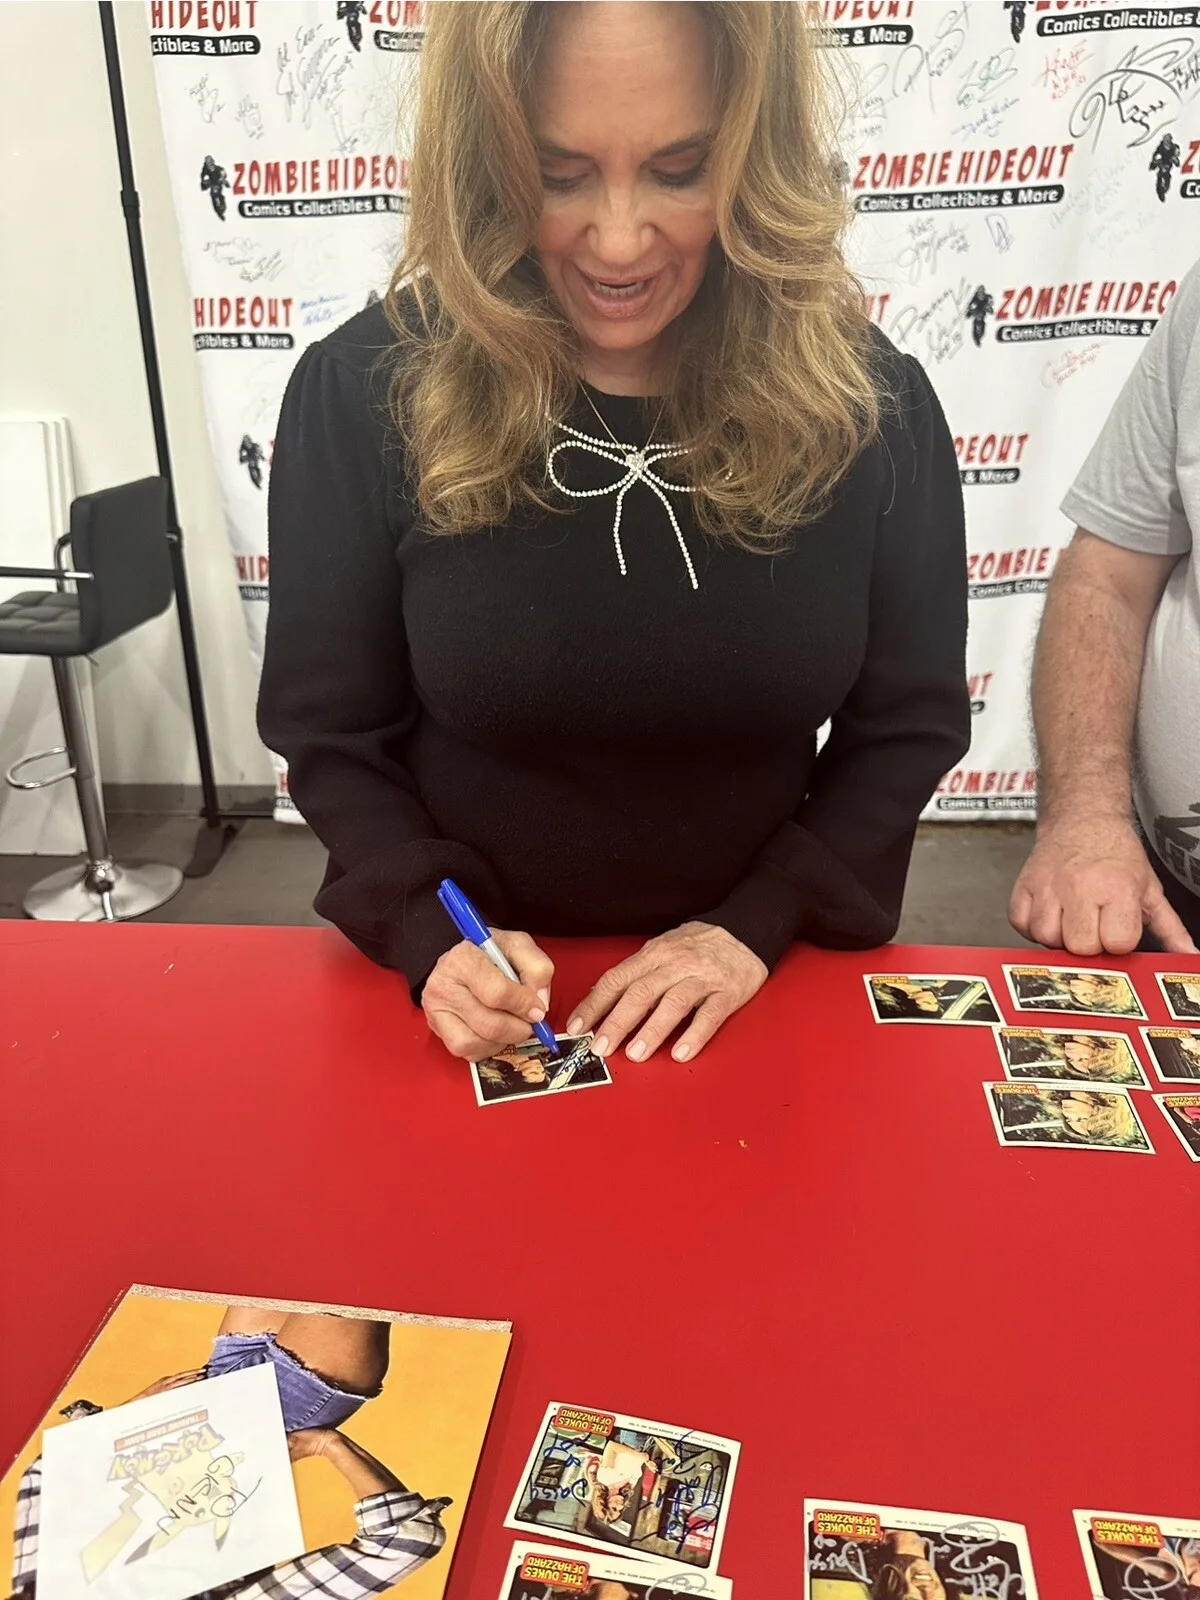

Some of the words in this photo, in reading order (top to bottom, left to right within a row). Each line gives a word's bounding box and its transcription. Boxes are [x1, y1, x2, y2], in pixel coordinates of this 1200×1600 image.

[151, 1, 259, 31] HIDEOUT
[1043, 15, 1100, 34] Comics
[1103, 11, 1193, 28] Collectibles
[853, 29, 865, 44] &
[869, 27, 907, 43] More
[203, 39, 216, 54] &
[219, 38, 254, 53] More
[853, 151, 952, 190] ZOMBIE
[957, 144, 1074, 185] HIDEOUT
[233, 159, 320, 196] ZOMBIE
[244, 202, 290, 216] Comics
[294, 198, 372, 215] Collectibles
[375, 197, 386, 211] &
[860, 196, 909, 211] Comics
[913, 192, 999, 209] Collectibles
[1001, 191, 1014, 205] &
[1018, 189, 1058, 204] More
[996, 281, 1092, 321] ZOMBIE
[194, 296, 294, 328] HIDEOUT
[1002, 325, 1051, 341] Comics
[1054, 319, 1138, 337] Collectibles
[1140, 322, 1152, 335] &
[241, 334, 253, 348] &
[255, 334, 290, 348] More
[968, 548, 1051, 578] ZOMBIE
[562, 1409, 600, 1421] HAZZARD
[600, 1417, 612, 1425] OF
[559, 1417, 587, 1429] DUKES
[592, 1424, 609, 1434] THE
[817, 1512, 861, 1524] HAZZARD
[862, 1518, 878, 1526] OF
[817, 1522, 852, 1533] DUKES
[854, 1525, 878, 1536] THE
[1096, 1520, 1144, 1533] HAZZARD
[1145, 1525, 1157, 1533] OF
[1098, 1530, 1135, 1543] DUKES
[1138, 1533, 1160, 1545] THE
[527, 1557, 571, 1570] HAZZARD
[571, 1565, 586, 1574] OF
[525, 1566, 560, 1581] DUKES
[562, 1573, 583, 1585] THE
